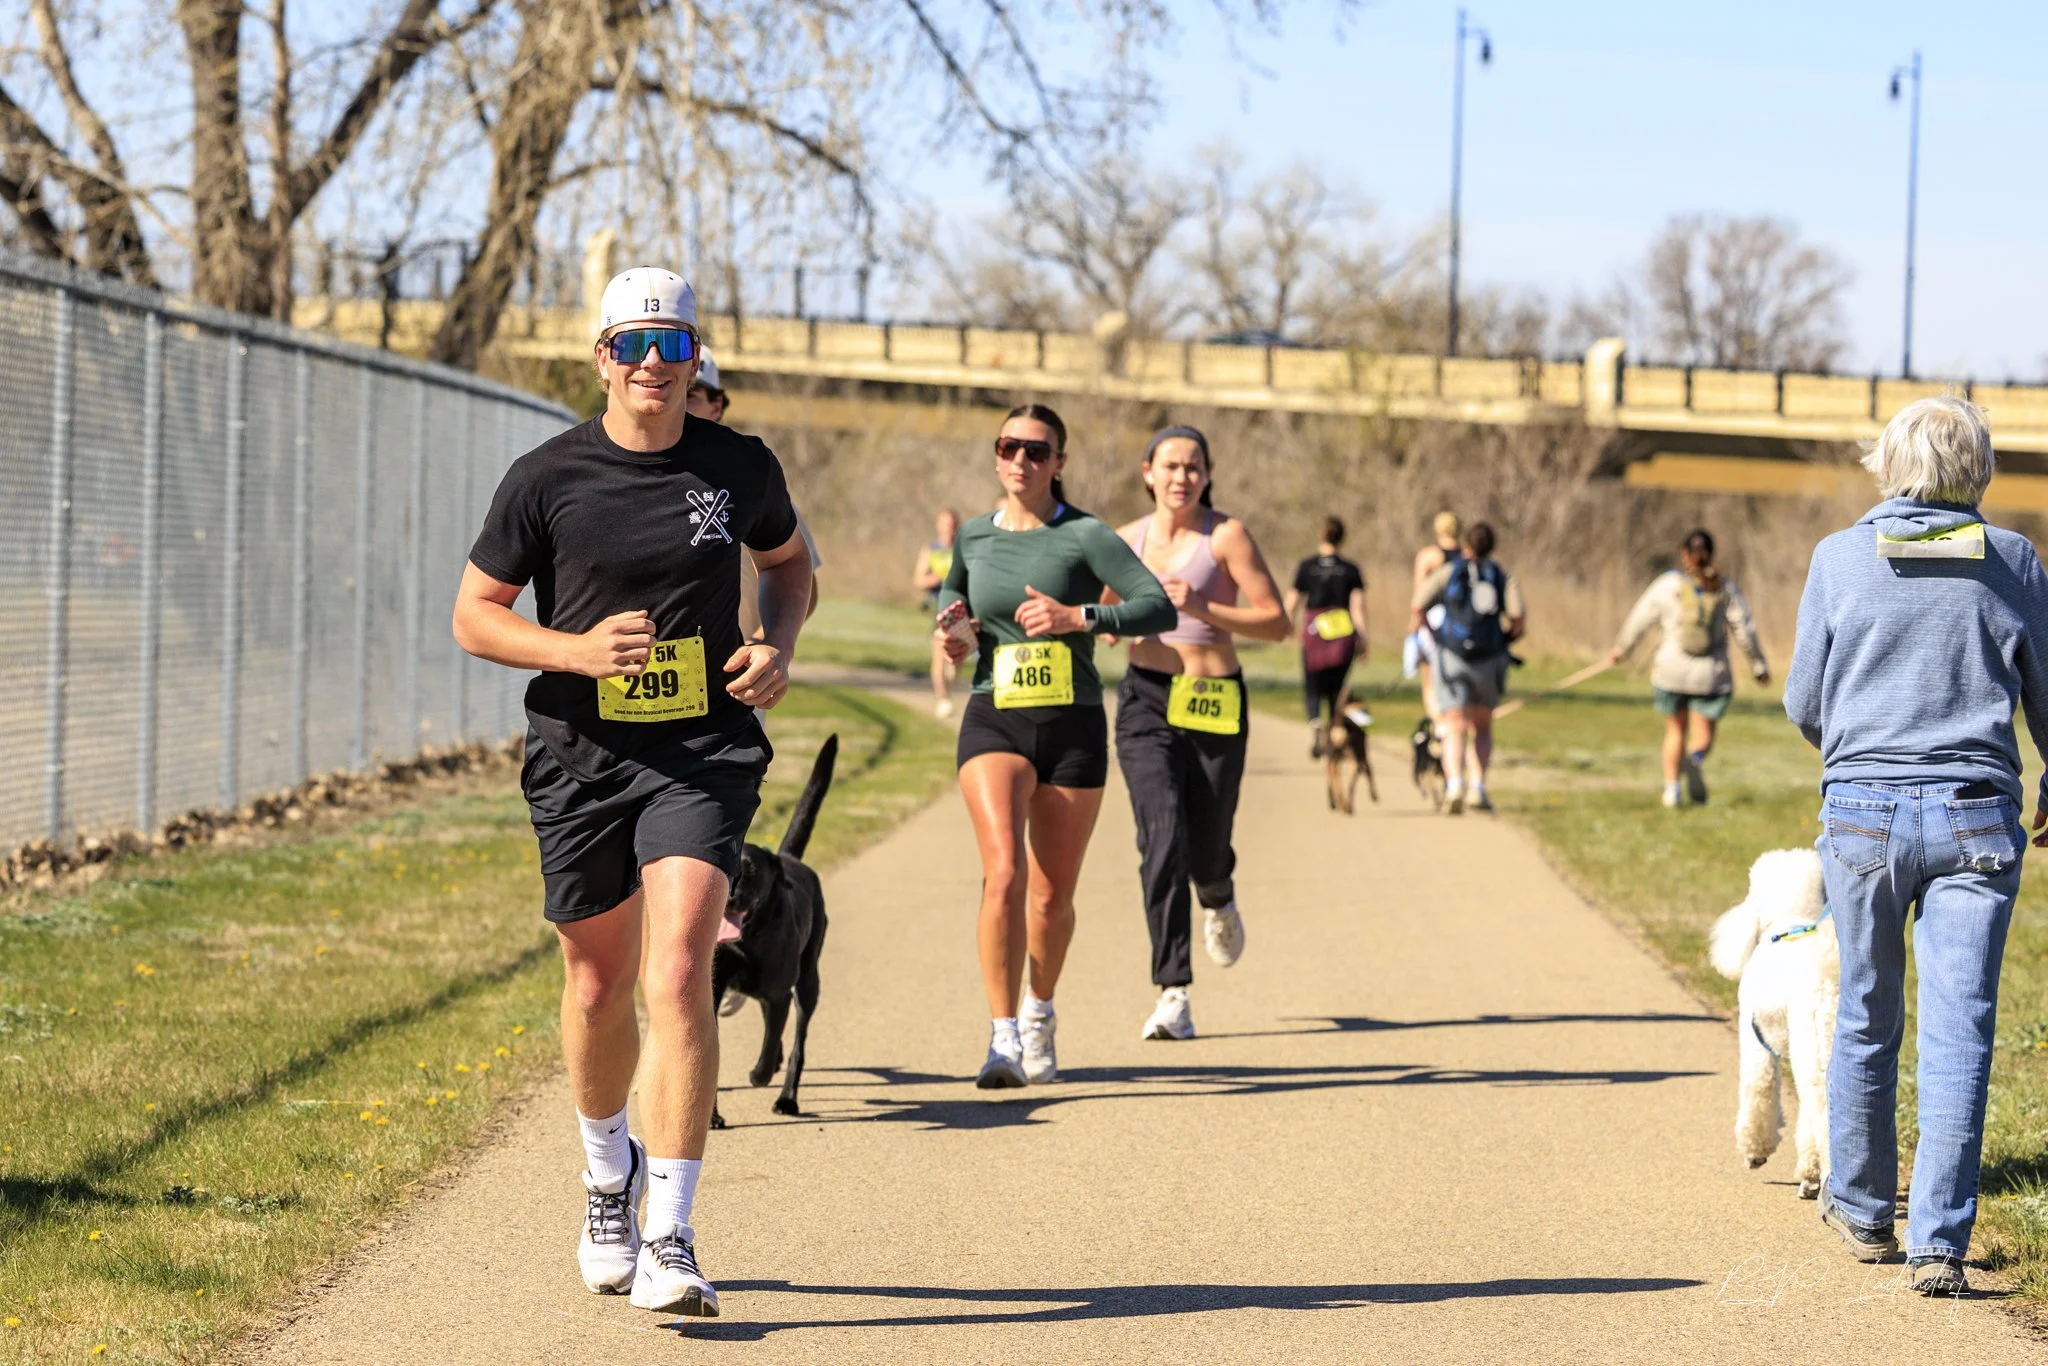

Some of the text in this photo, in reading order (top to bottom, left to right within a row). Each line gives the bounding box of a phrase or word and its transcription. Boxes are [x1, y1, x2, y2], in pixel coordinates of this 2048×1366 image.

[643, 298, 660, 313] 13
[655, 644, 678, 663] 5K
[1035, 647, 1051, 659] 5K
[623, 668, 680, 700] 299
[1013, 665, 1052, 687] 486
[1187, 697, 1221, 717] 405
